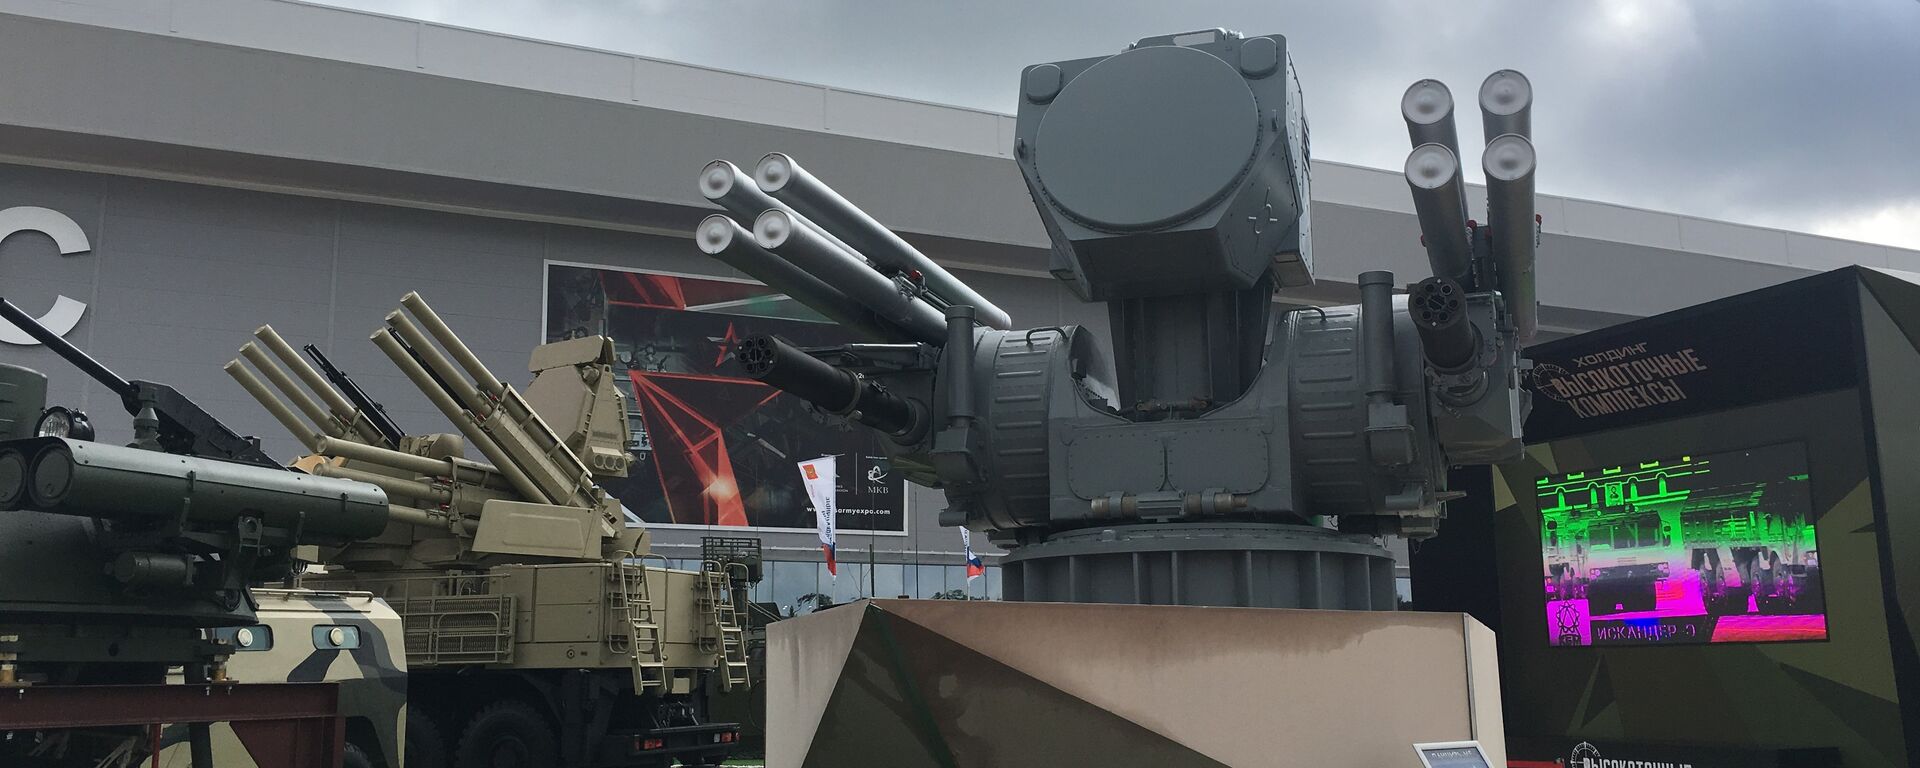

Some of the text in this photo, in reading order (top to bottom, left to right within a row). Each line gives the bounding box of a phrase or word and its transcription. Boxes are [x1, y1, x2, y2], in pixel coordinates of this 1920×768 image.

[1550, 349, 1707, 398] ВЫСОКОТОЧНЫЕ
[1572, 342, 1647, 368] ХОЛДИНГ
[1567, 379, 1687, 418] КОМПЛЕКСЫ
